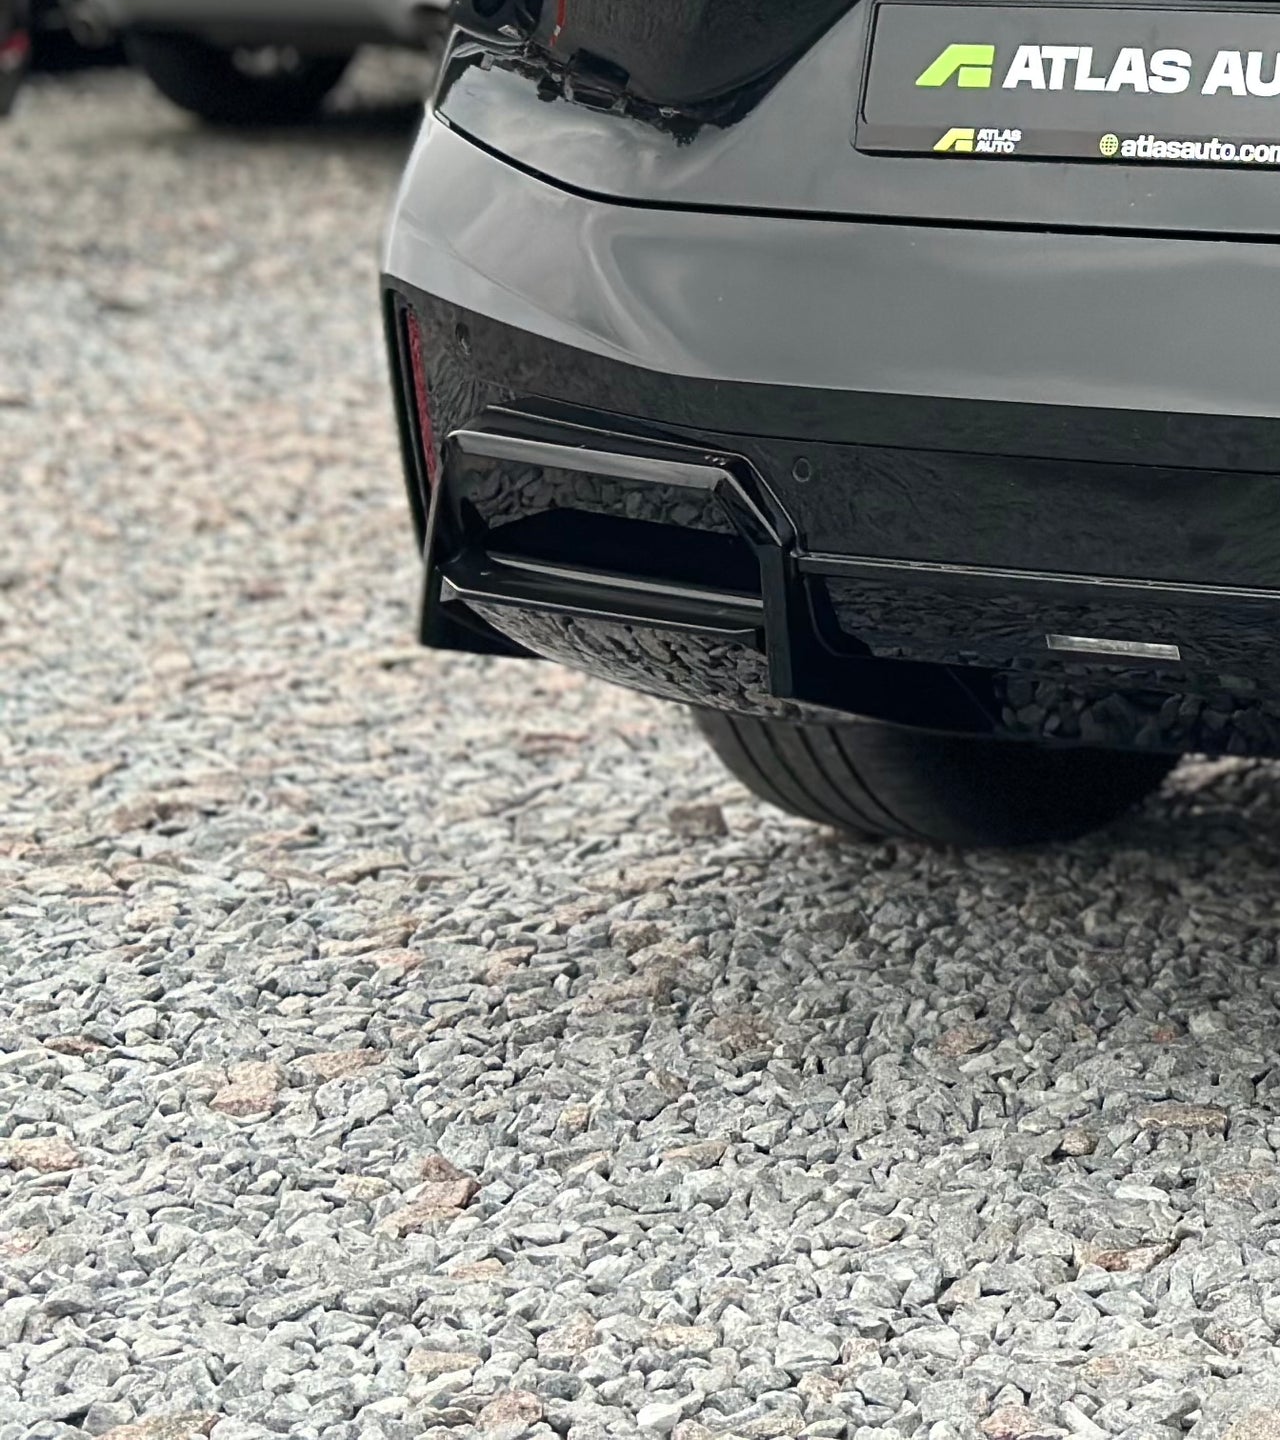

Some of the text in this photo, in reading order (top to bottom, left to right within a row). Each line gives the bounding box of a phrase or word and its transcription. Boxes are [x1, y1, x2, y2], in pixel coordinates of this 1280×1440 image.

[1002, 45, 1193, 94] ATLAS
[976, 128, 1022, 142] ATLAS
[975, 140, 1015, 153] AUTO
